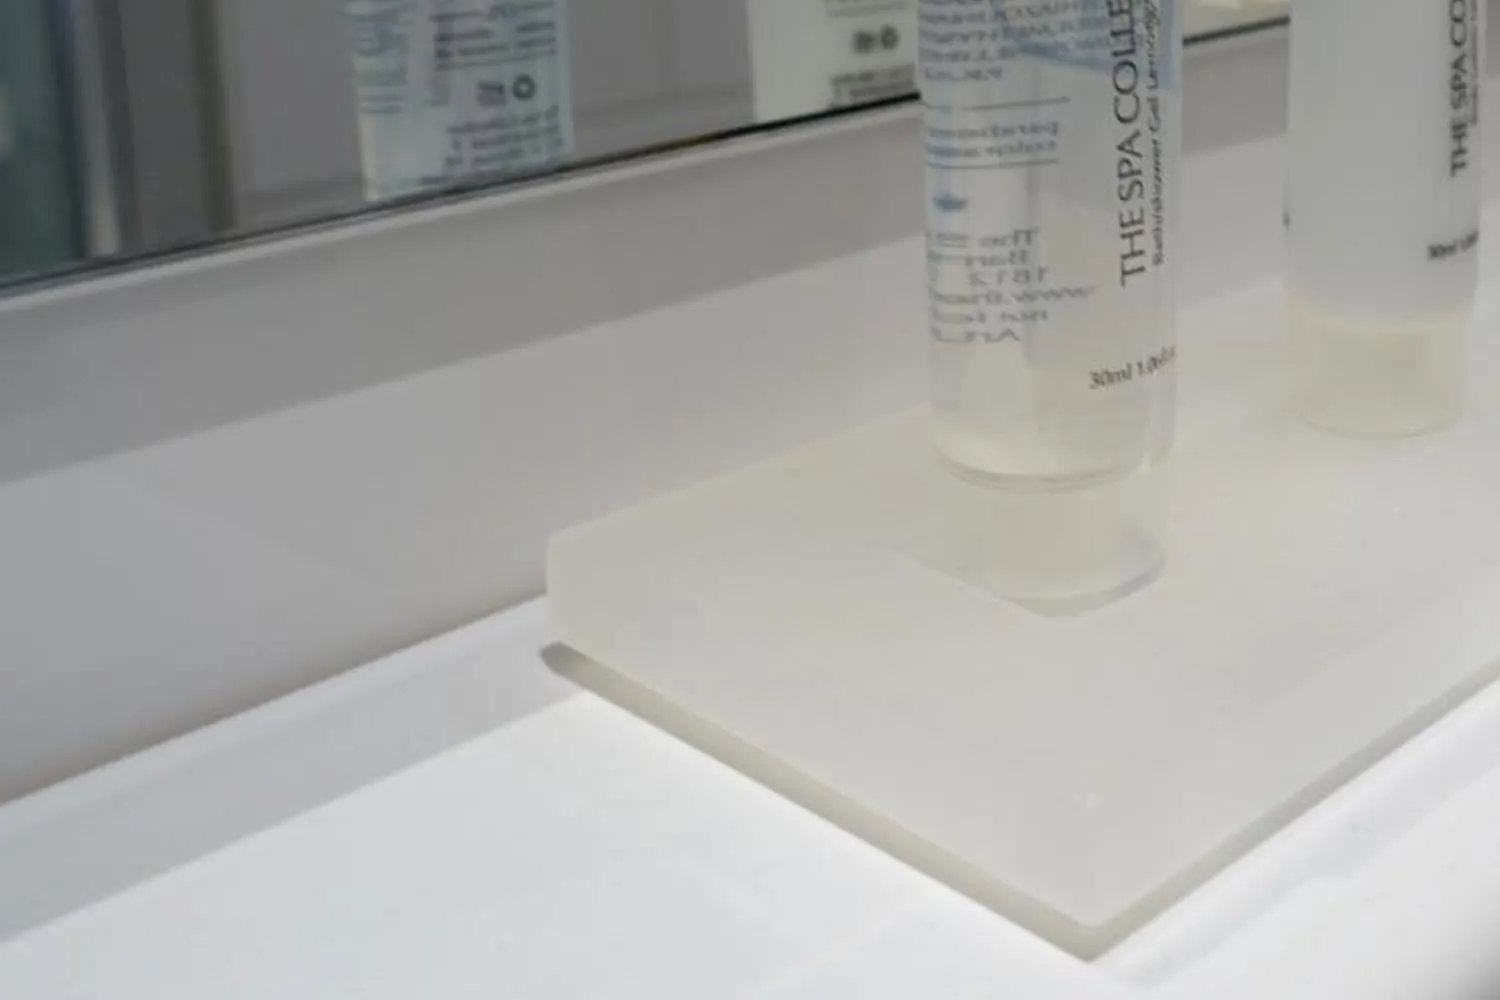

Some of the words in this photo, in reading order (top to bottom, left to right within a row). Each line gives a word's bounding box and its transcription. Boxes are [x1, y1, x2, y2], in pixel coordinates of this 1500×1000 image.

[1450, 52, 1468, 111] SPA
[1116, 129, 1144, 202] SPA
[1450, 121, 1469, 178] THE
[1119, 206, 1147, 288] THE
